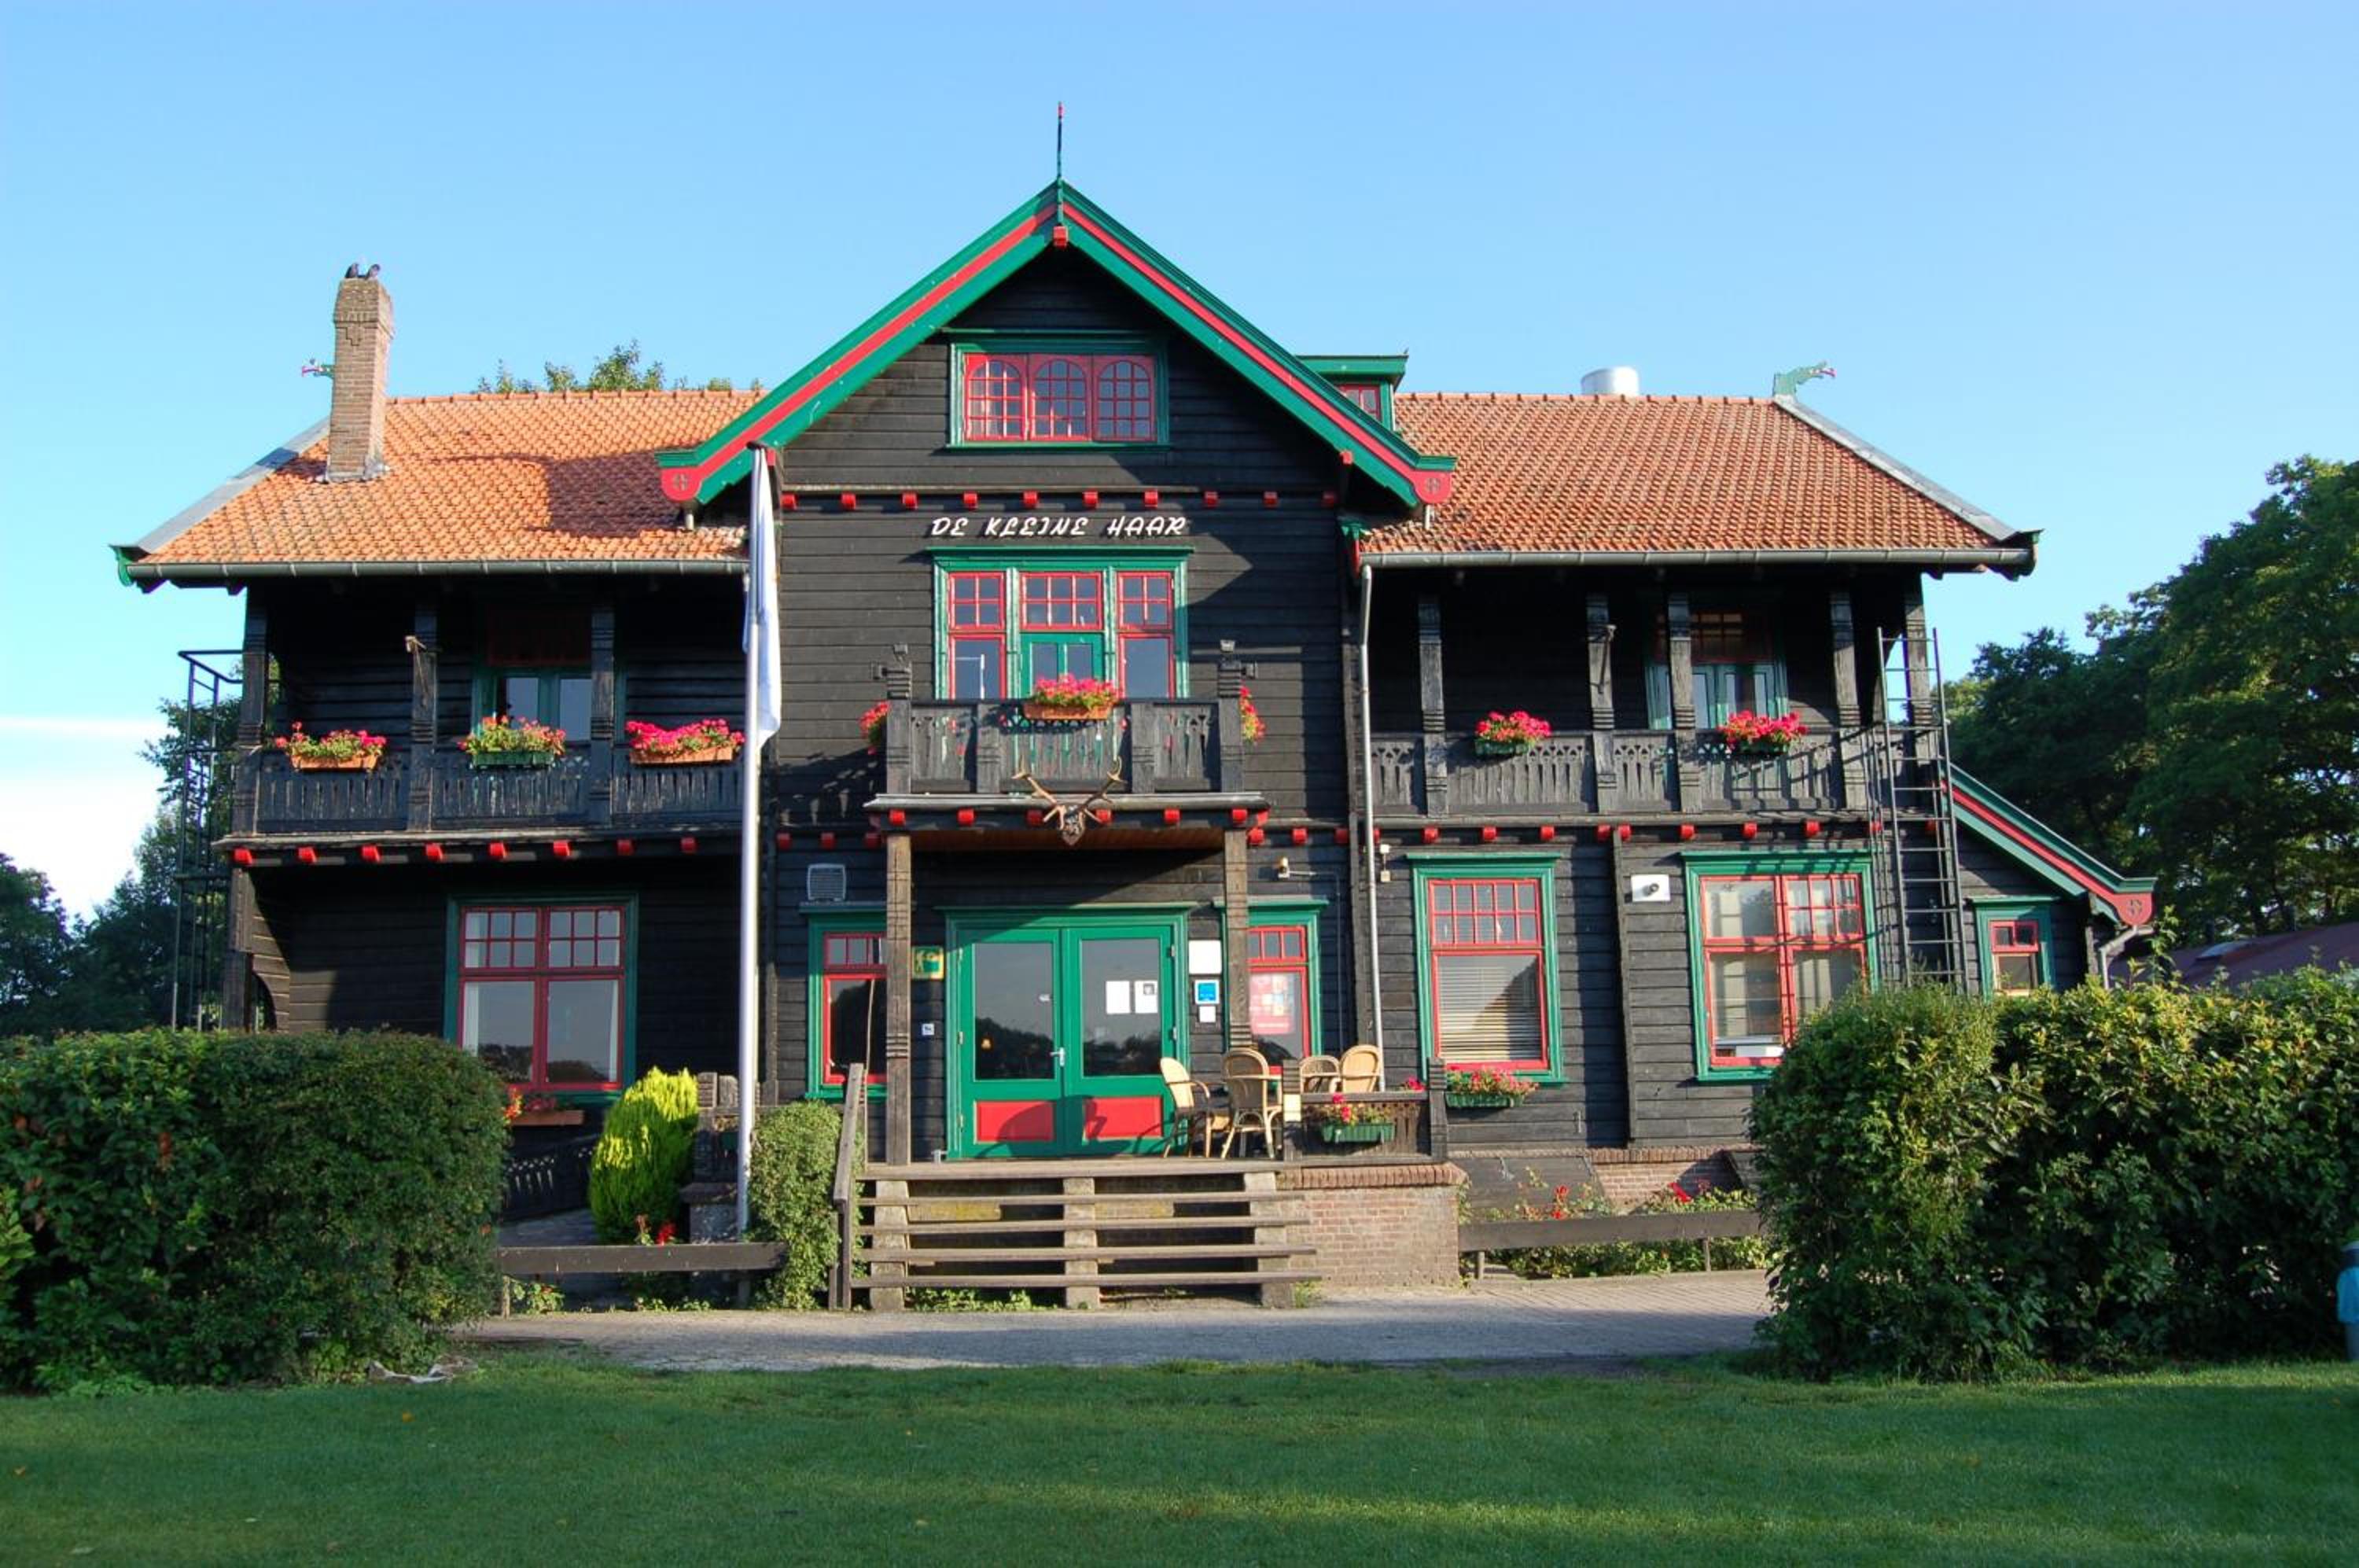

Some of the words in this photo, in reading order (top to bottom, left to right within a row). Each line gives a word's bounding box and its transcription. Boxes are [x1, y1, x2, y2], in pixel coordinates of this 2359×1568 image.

[931, 517, 969, 536] DE
[984, 517, 1089, 536] KLEINE
[1107, 516, 1187, 536] HAAR
